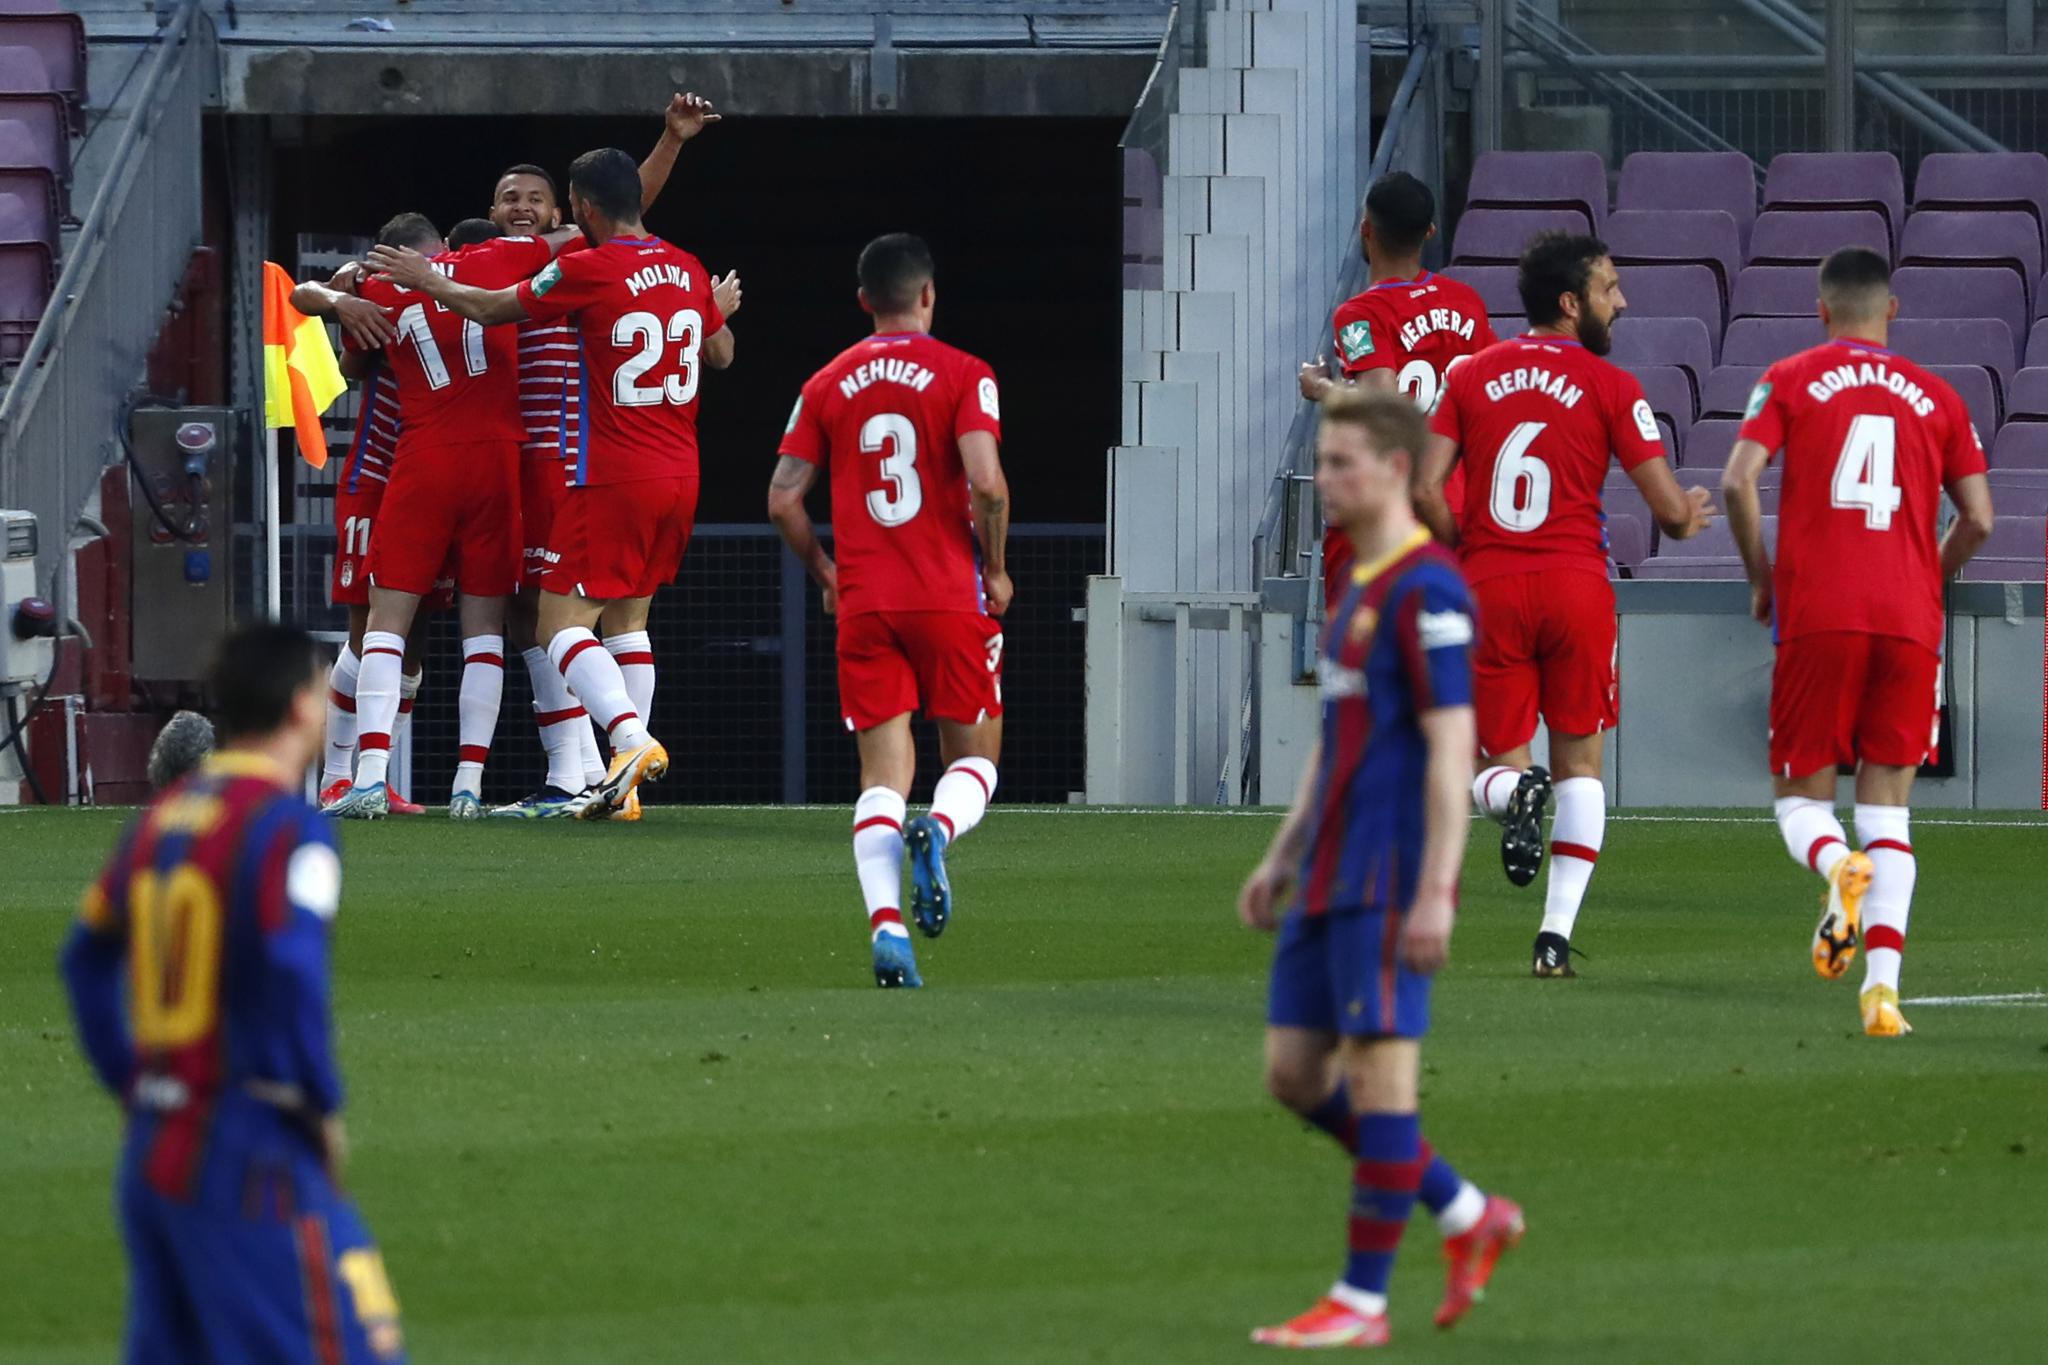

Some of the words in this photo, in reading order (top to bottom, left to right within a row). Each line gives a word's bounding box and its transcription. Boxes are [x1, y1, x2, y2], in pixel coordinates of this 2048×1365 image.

[624, 263, 692, 297] MOLINA
[1399, 308, 1476, 353] HERRERA
[611, 308, 704, 408] 23
[839, 358, 936, 399] NEHUEN
[1396, 354, 1473, 416] 2
[1484, 366, 1584, 409] GERMÁN
[1807, 362, 1936, 418] GONALONS
[859, 412, 923, 528] 3
[1489, 421, 1553, 533] 6
[1830, 414, 1903, 531] 4
[343, 515, 372, 556] 11
[984, 631, 1005, 673] 3
